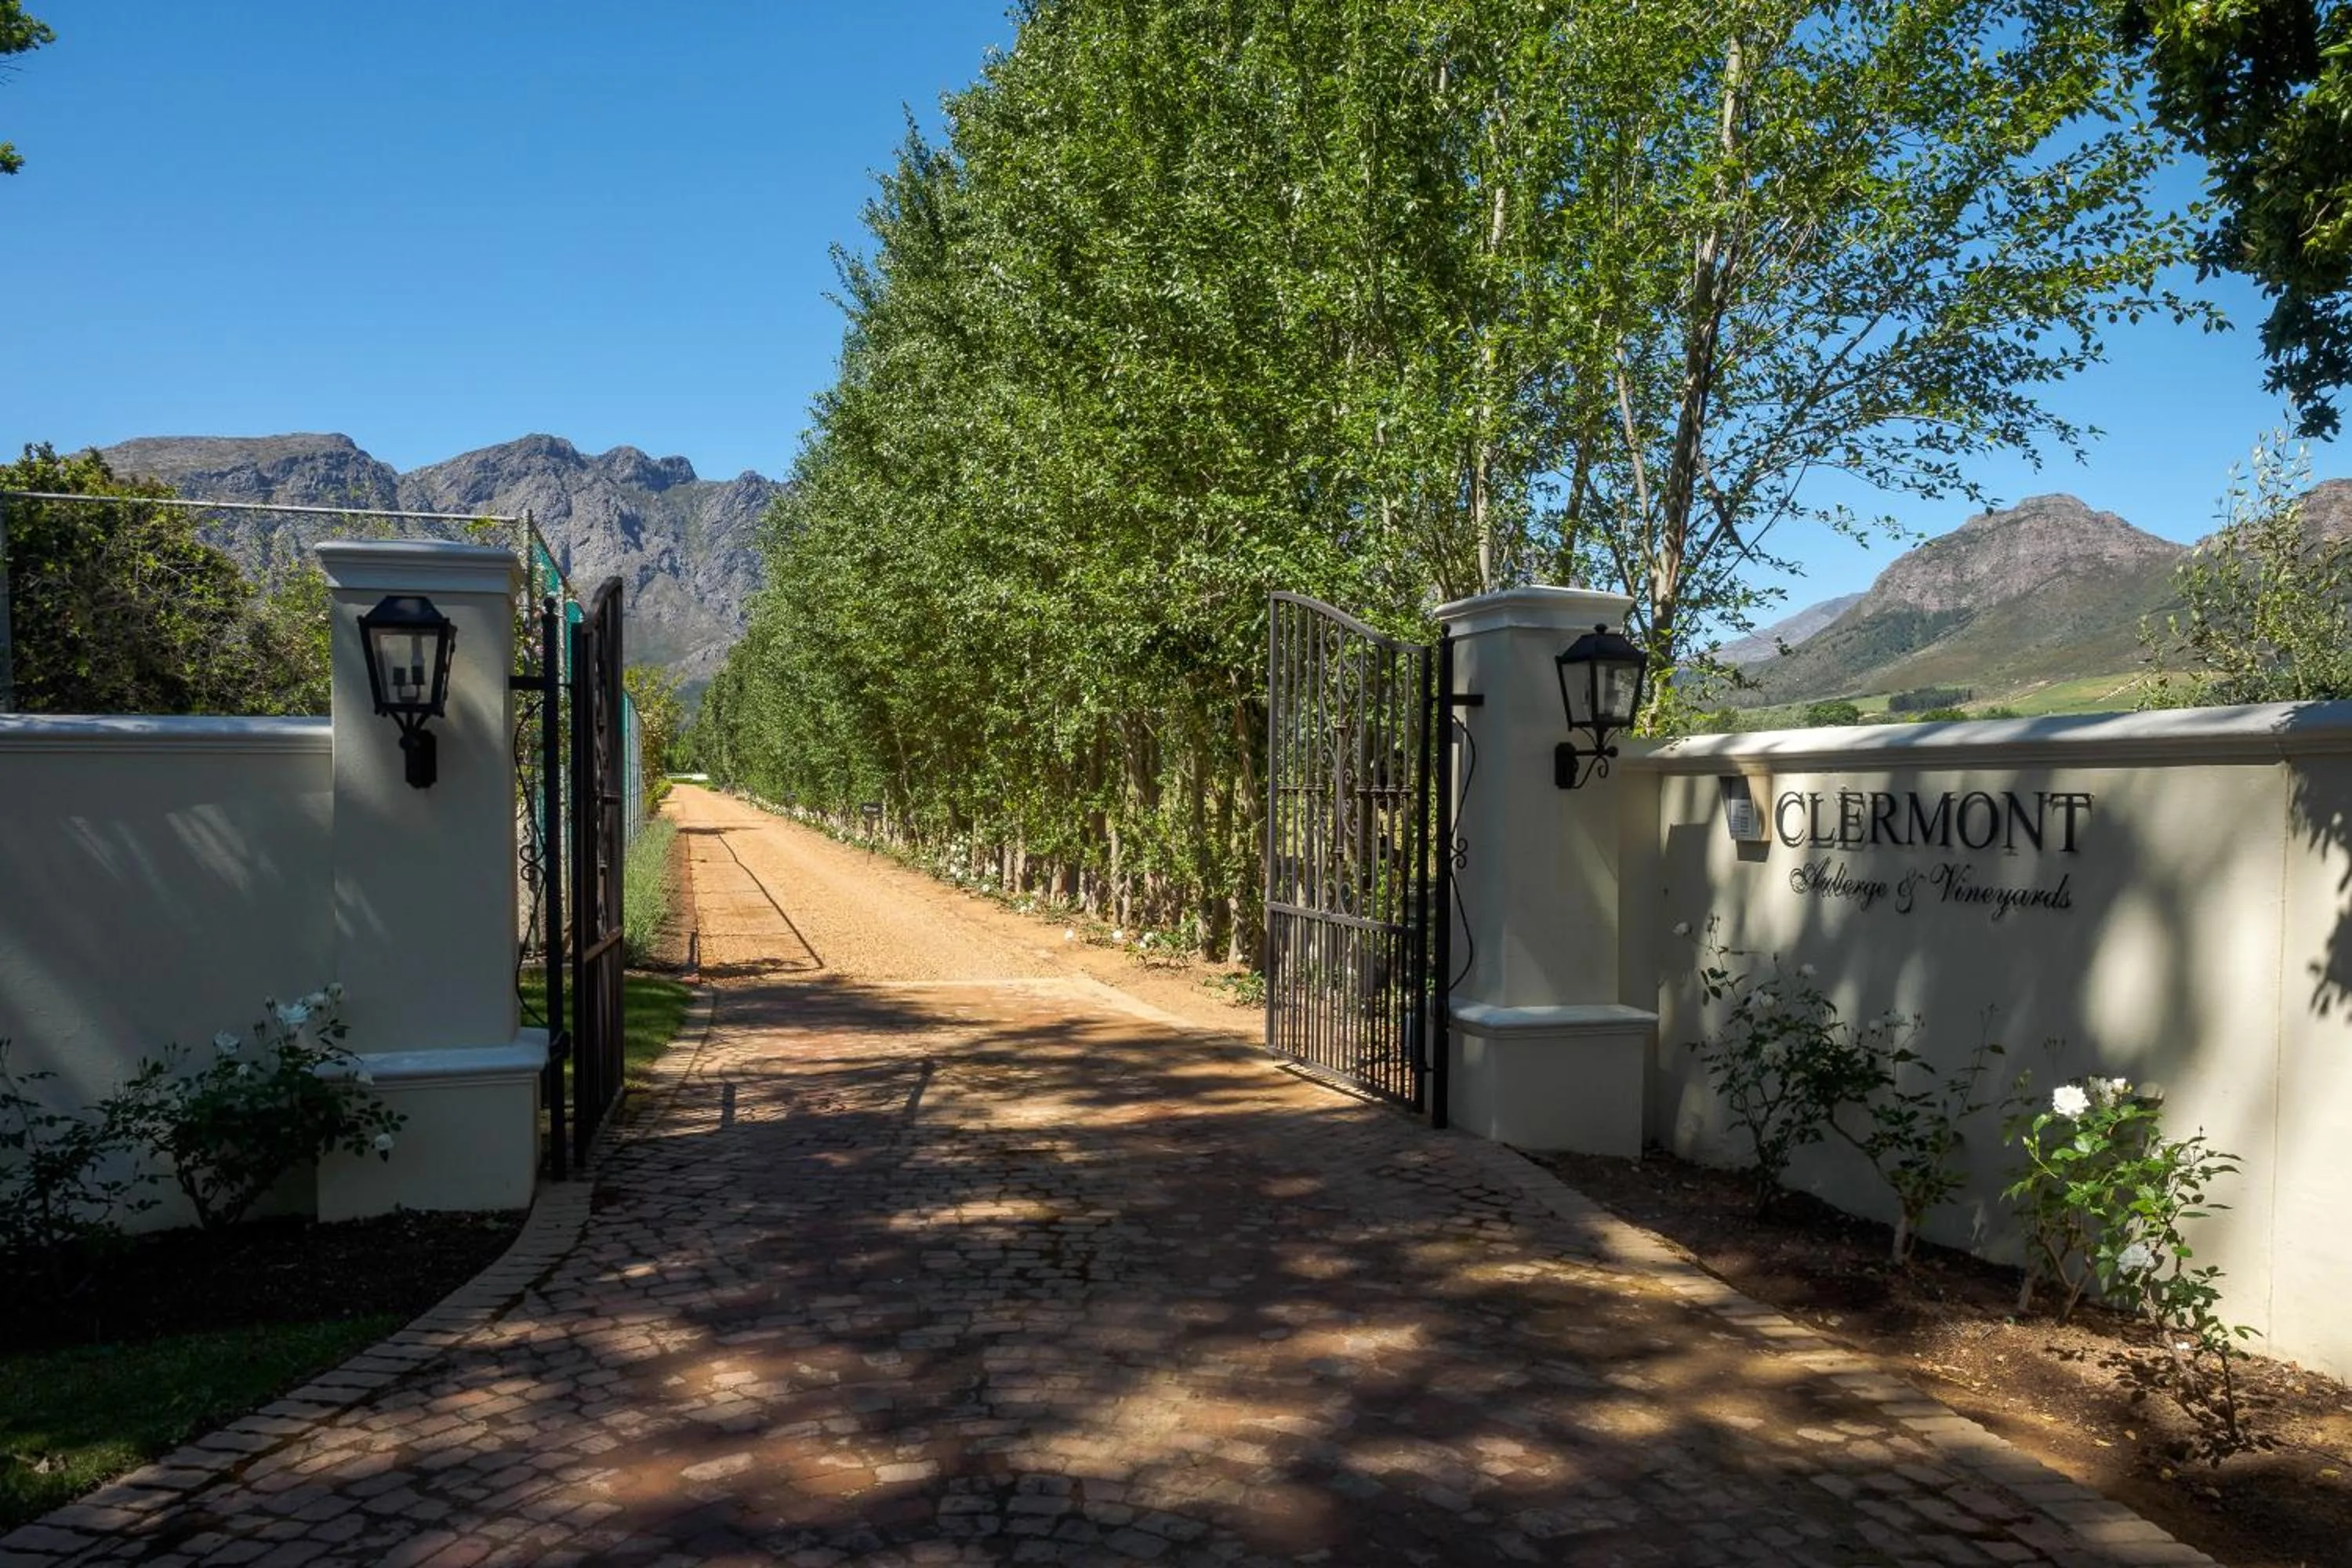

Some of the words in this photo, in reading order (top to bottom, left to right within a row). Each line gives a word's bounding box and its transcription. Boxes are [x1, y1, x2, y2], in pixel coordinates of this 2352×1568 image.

[1775, 789, 2094, 852] CLERMONT
[1789, 856, 1887, 911] Auberge
[1896, 866, 1925, 914] &
[1930, 862, 2072, 922] Vineyards
